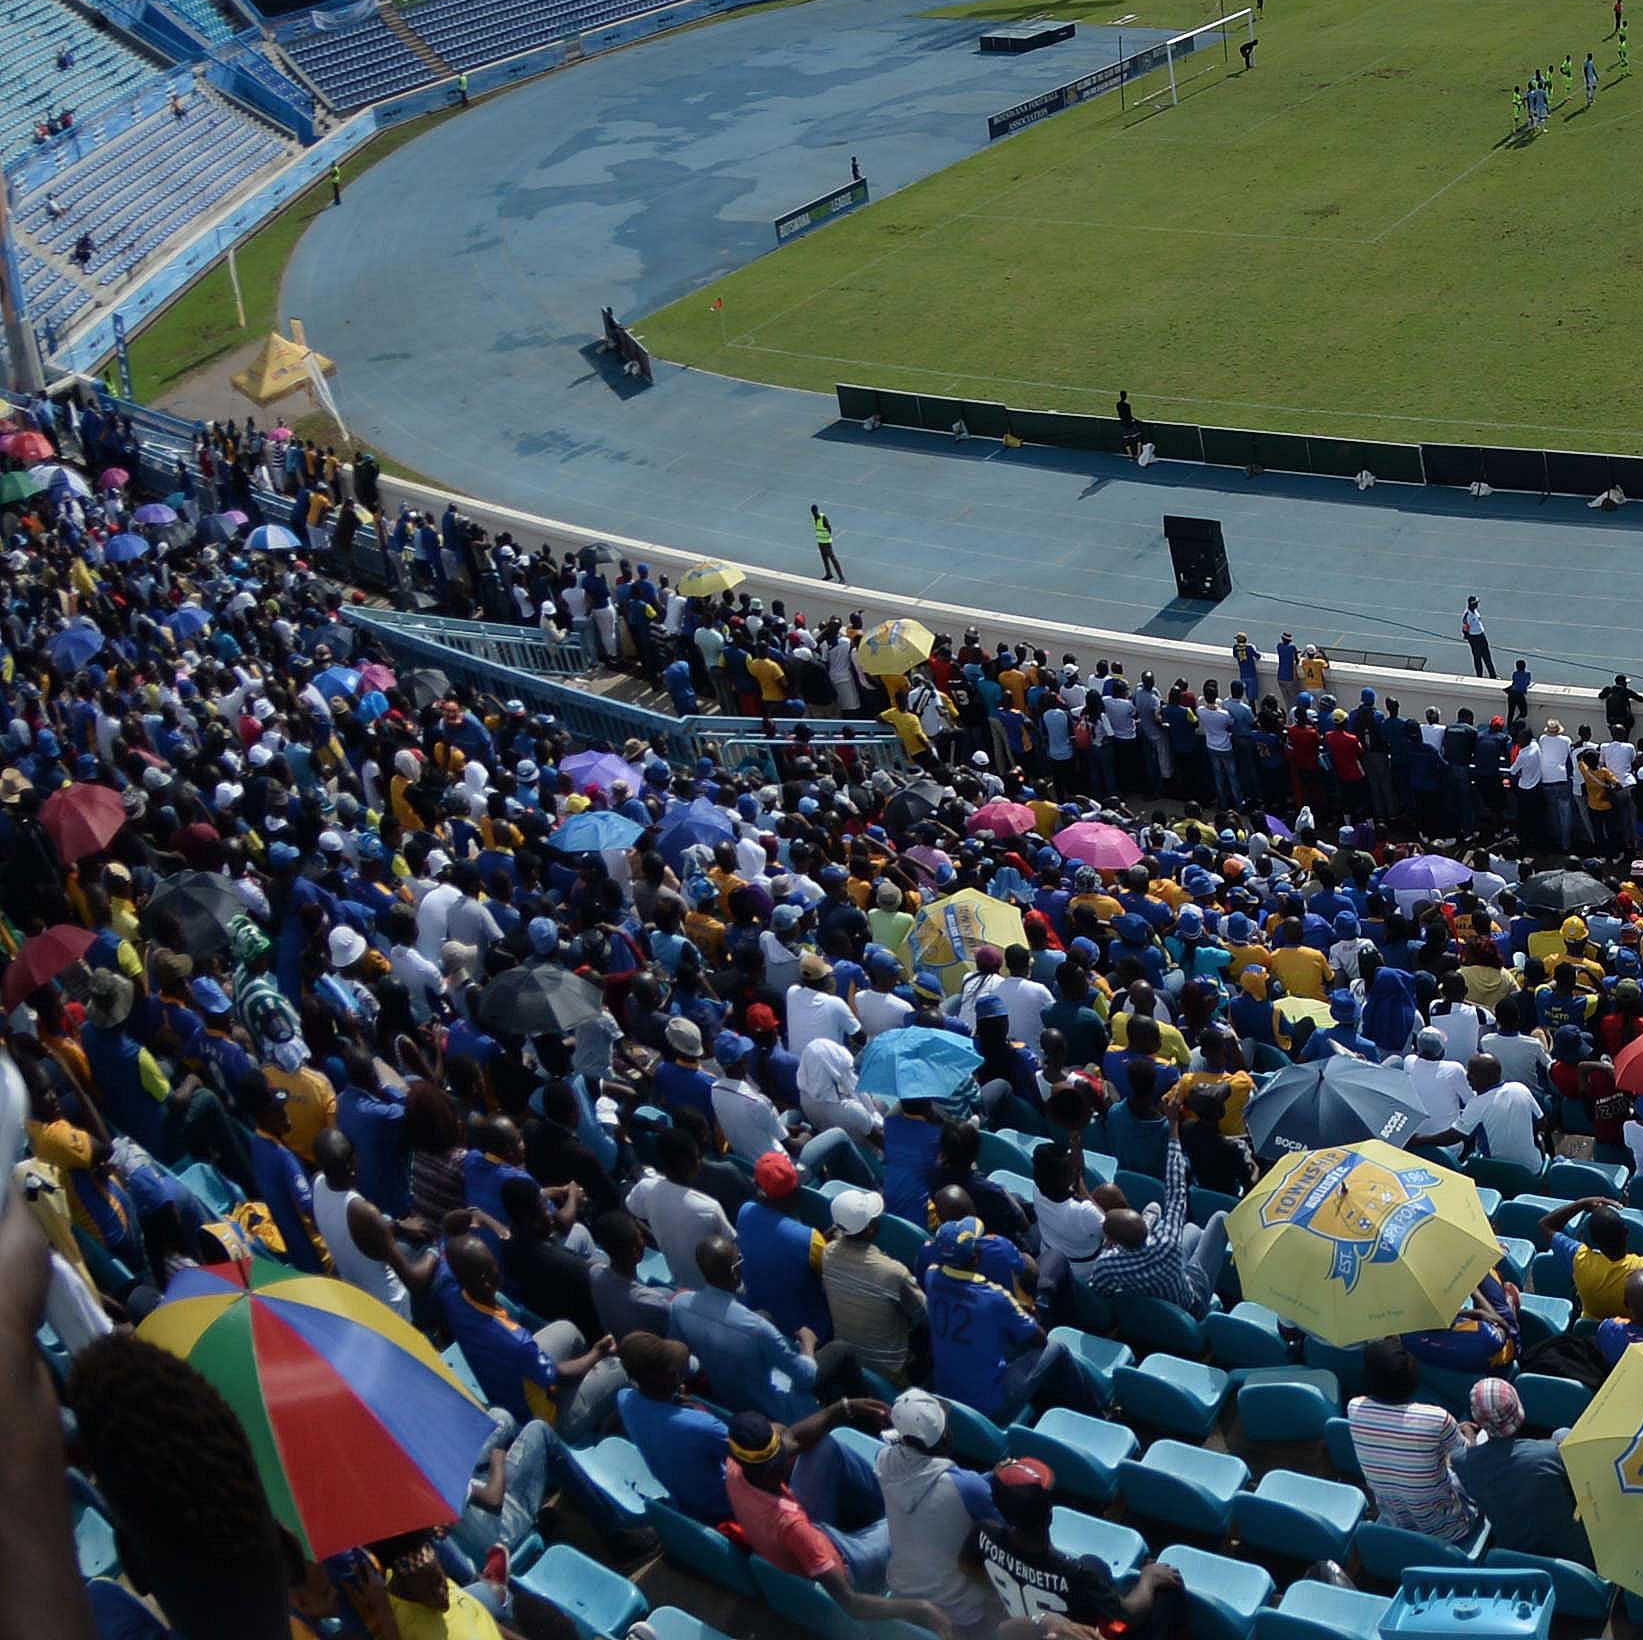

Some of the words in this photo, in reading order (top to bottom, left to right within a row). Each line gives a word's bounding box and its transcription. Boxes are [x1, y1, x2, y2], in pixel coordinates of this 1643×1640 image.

[1380, 1111, 1402, 1138] BOCRA
[1274, 1135, 1309, 1152] BOCRA
[1275, 1152, 1338, 1215] TOWNSHIP
